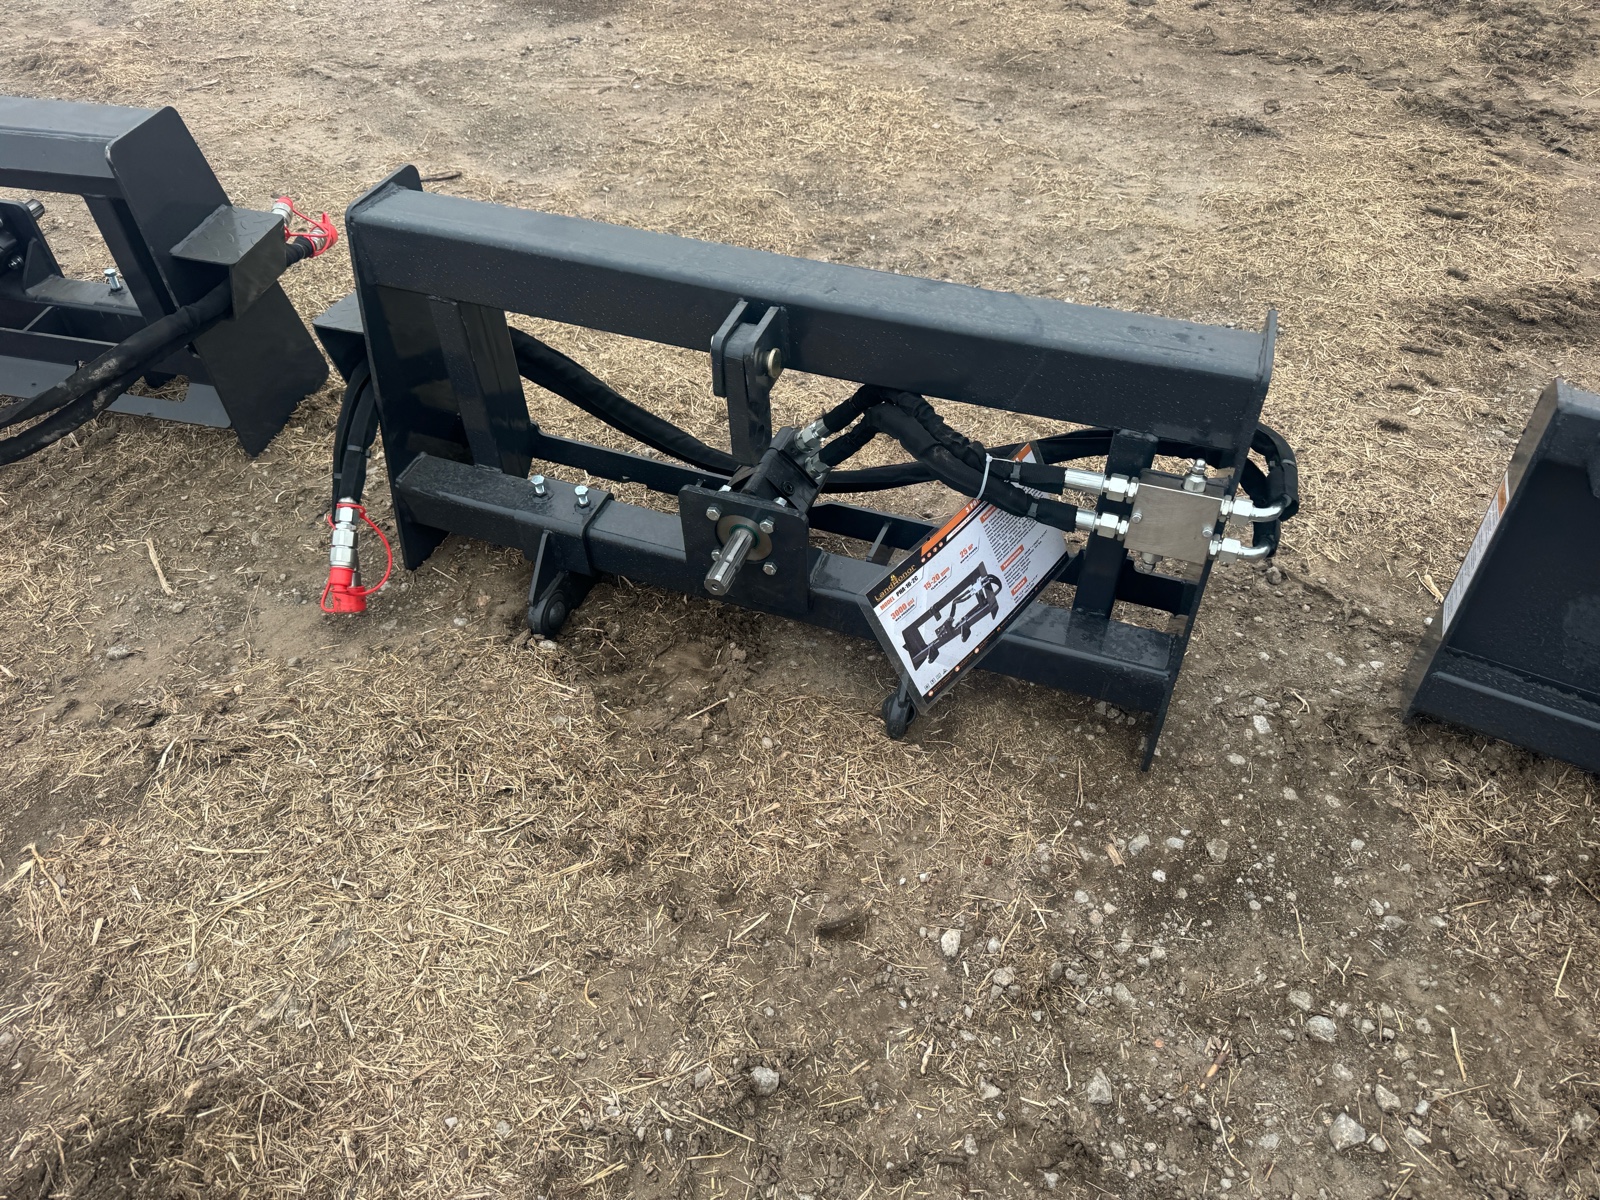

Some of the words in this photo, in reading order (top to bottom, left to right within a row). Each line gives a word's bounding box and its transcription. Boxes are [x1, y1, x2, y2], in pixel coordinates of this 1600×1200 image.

[959, 548, 968, 558] 25
[874, 564, 917, 602] LandHonor
[923, 573, 940, 590] 15-20
[880, 596, 895, 611] MODEL
[891, 602, 908, 620] 3000
